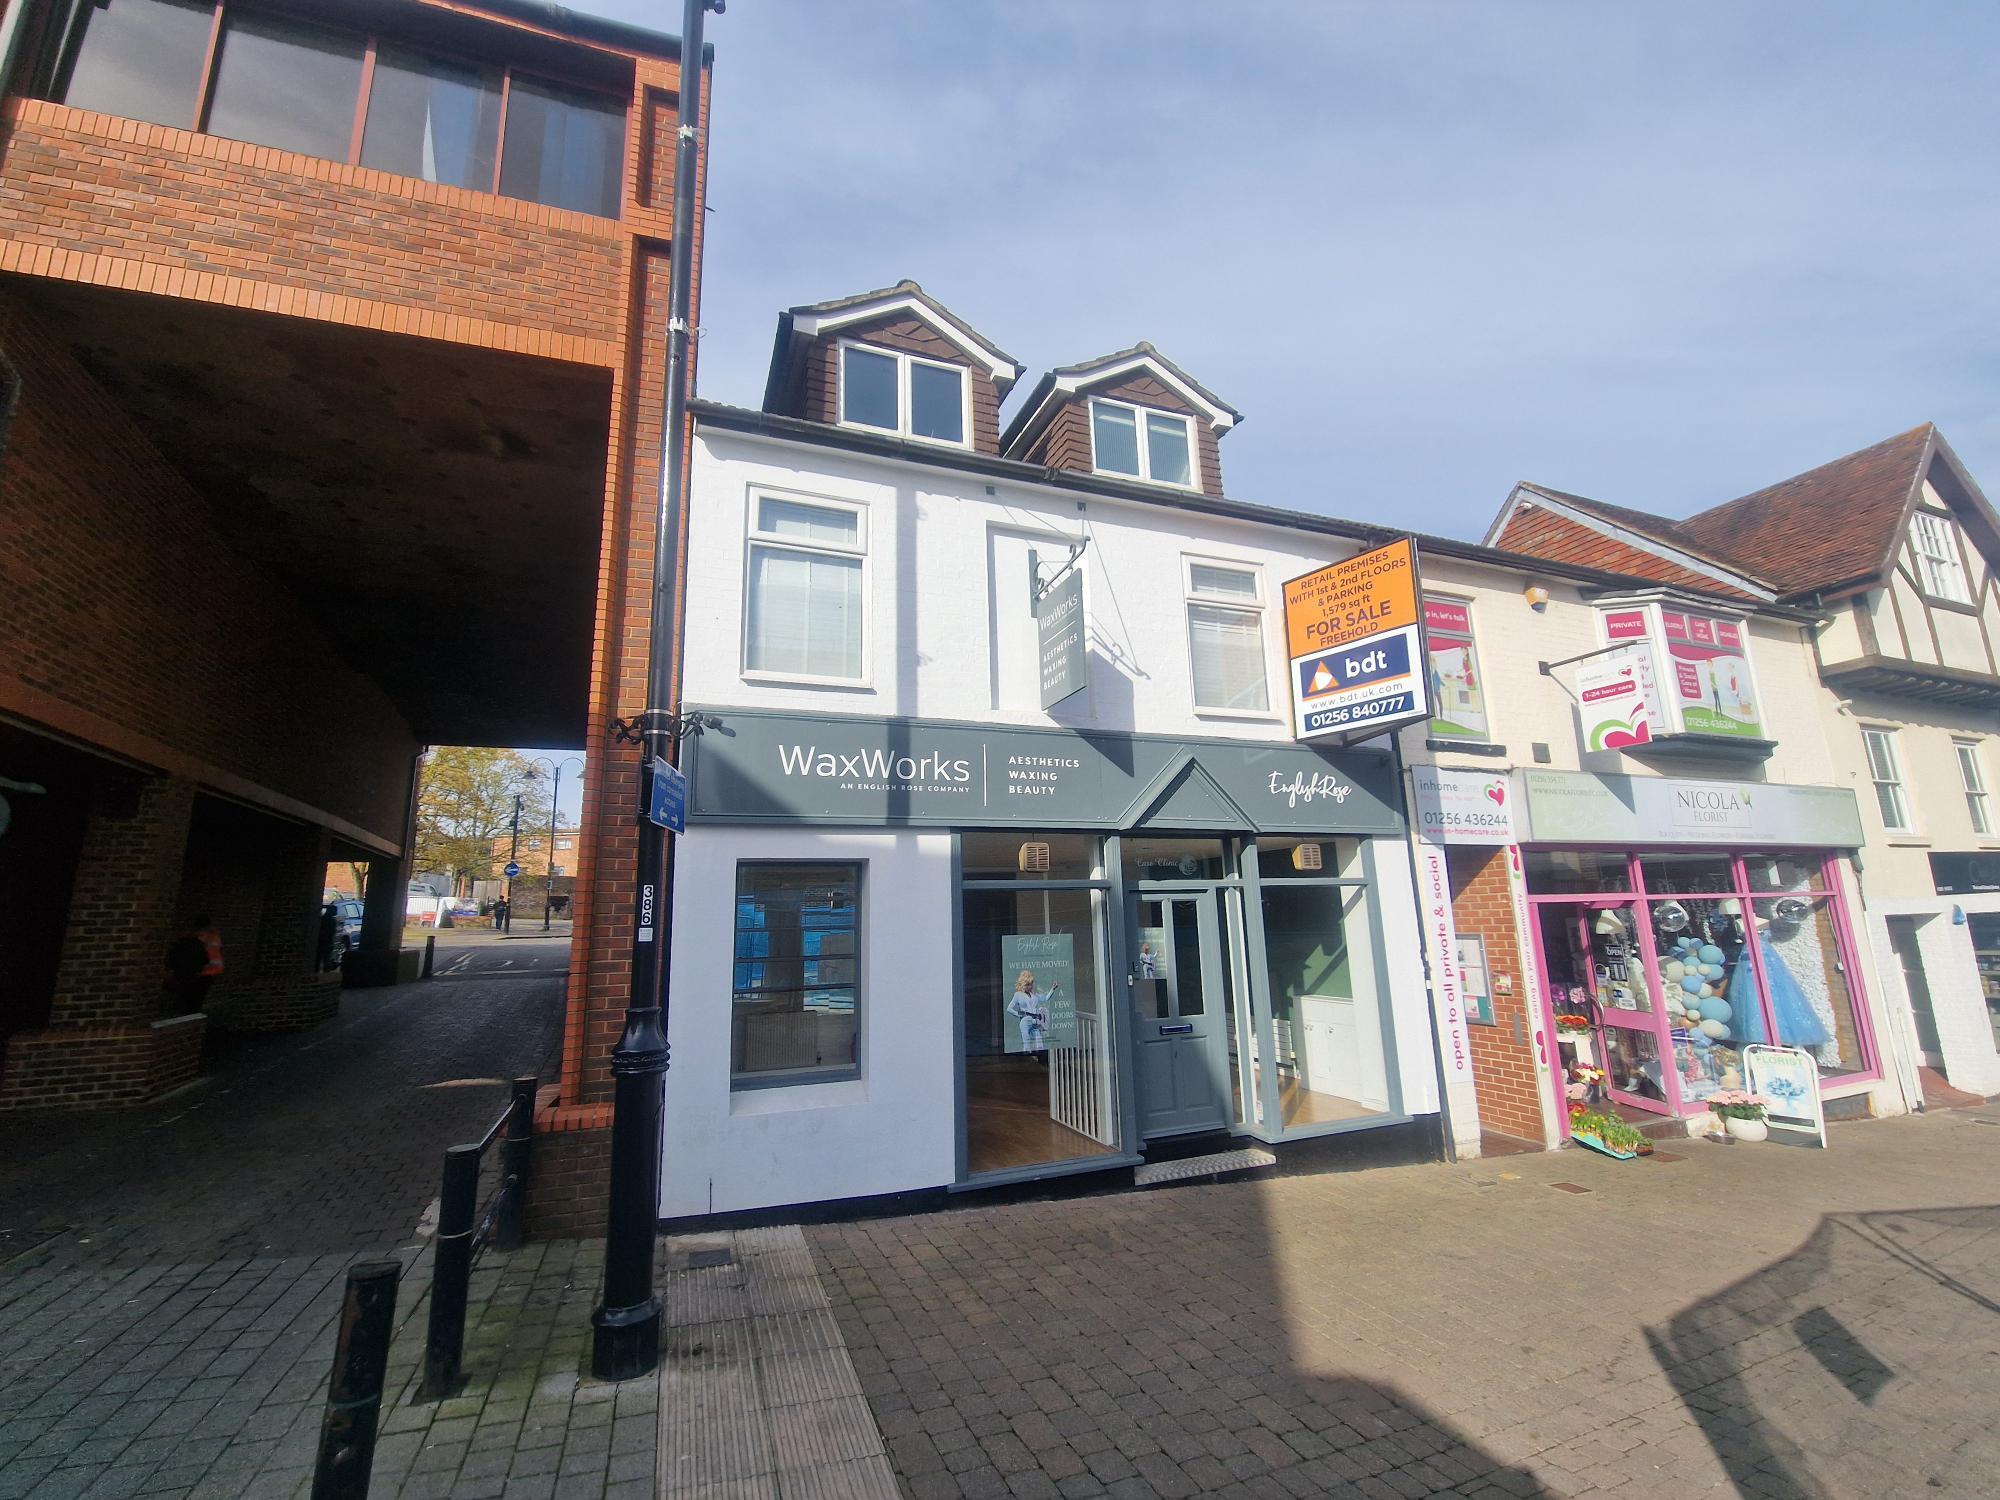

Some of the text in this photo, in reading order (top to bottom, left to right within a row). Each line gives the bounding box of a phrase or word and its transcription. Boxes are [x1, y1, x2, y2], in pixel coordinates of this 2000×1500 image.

[1289, 557, 1406, 605] WITH 1st & 2nd FLOORS
[1301, 551, 1389, 589] RETAIL PREMISES
[1318, 581, 1373, 607] & PARKING
[1039, 594, 1078, 631] WaxWorks
[1322, 594, 1371, 618] 1,579 sq ft
[1306, 599, 1392, 640] FOR SALE
[1610, 620, 1643, 629] PRIVATE
[1320, 621, 1378, 647] FREEHOLD
[1043, 633, 1078, 662] AESTHETICS
[1043, 656, 1067, 676] WAXING
[1345, 650, 1388, 679] bdt
[1043, 671, 1066, 690] BEAUTY
[1310, 681, 1403, 710] www.bdt.uk.com
[1584, 690, 1601, 699] 1-24
[1601, 687, 1617, 695] hour
[1311, 696, 1405, 728] 01256 840777
[778, 744, 971, 782] WaxWorks
[1008, 755, 1080, 768] AESTHETICS
[1008, 770, 1058, 782] WAXING
[857, 783, 898, 791] ENGLISH
[901, 784, 924, 792] ROSE
[927, 785, 971, 793] COMPANY
[1008, 784, 1056, 796] BEAUTY
[1676, 789, 1740, 811] NICOLA
[1424, 811, 1508, 827] 01256 436244
[1693, 811, 1729, 824] FLORIST
[641, 885, 654, 925] 386
[1021, 961, 1041, 969] HAVE
[1427, 856, 1465, 1070] open to all private & social
[1051, 1012, 1074, 1020] DOORS
[1054, 1001, 1071, 1009] FEW
[1755, 1055, 1804, 1067] FLORIST
